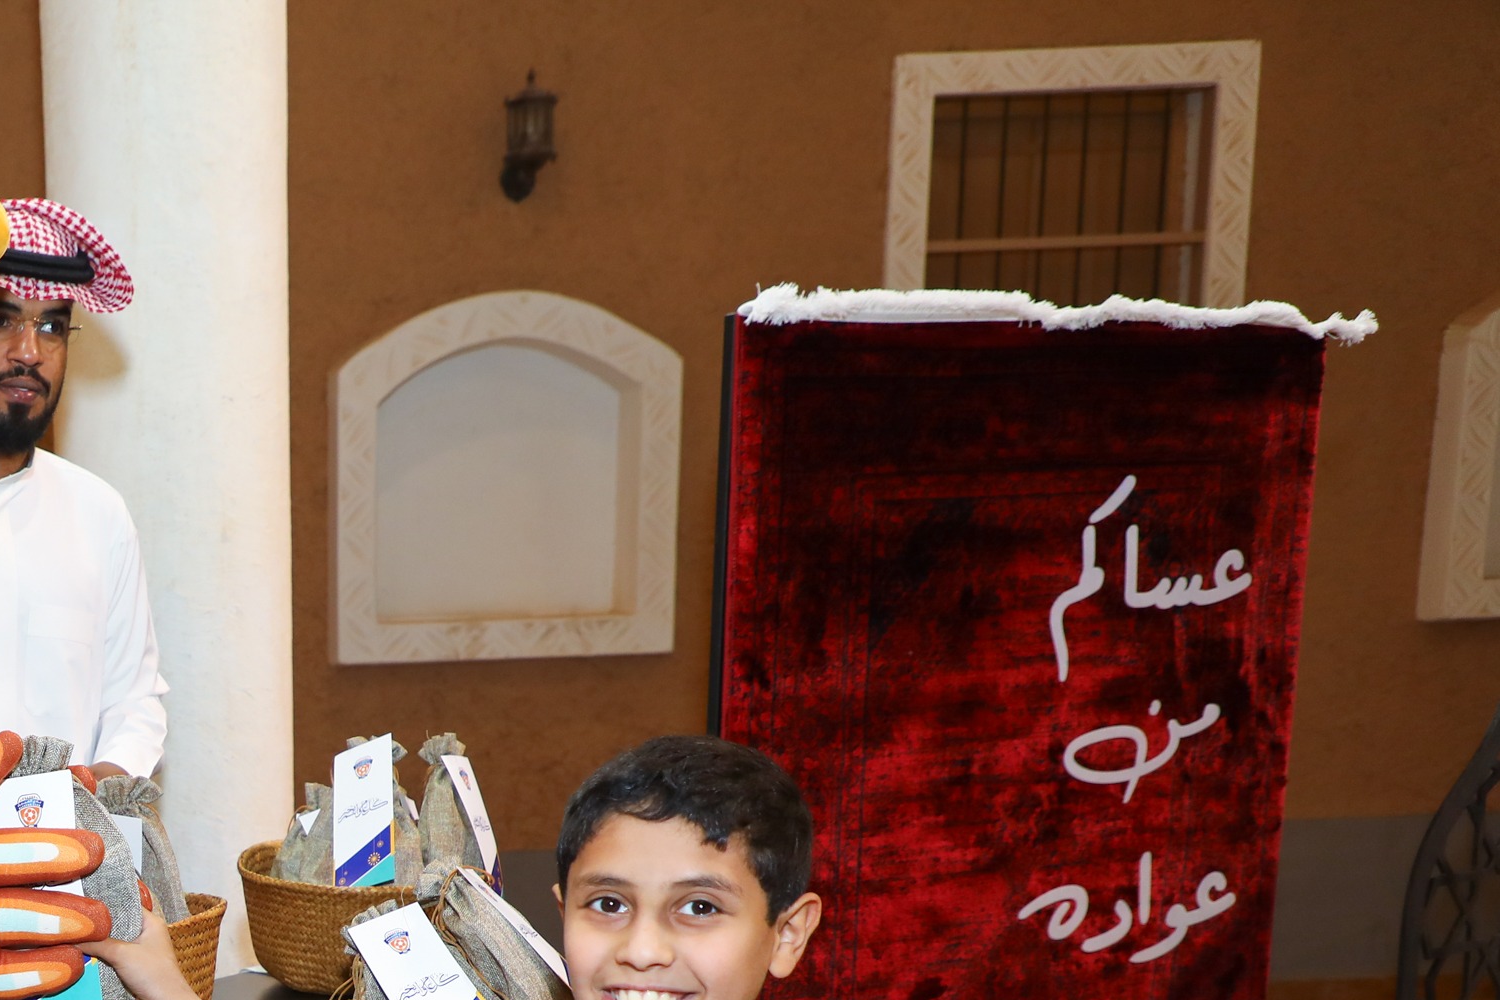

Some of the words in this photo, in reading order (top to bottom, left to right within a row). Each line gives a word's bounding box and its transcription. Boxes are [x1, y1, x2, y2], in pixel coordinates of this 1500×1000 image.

[1049, 474, 1252, 683] عساكم
[1063, 700, 1221, 804] من
[1018, 851, 1236, 964] عواده
